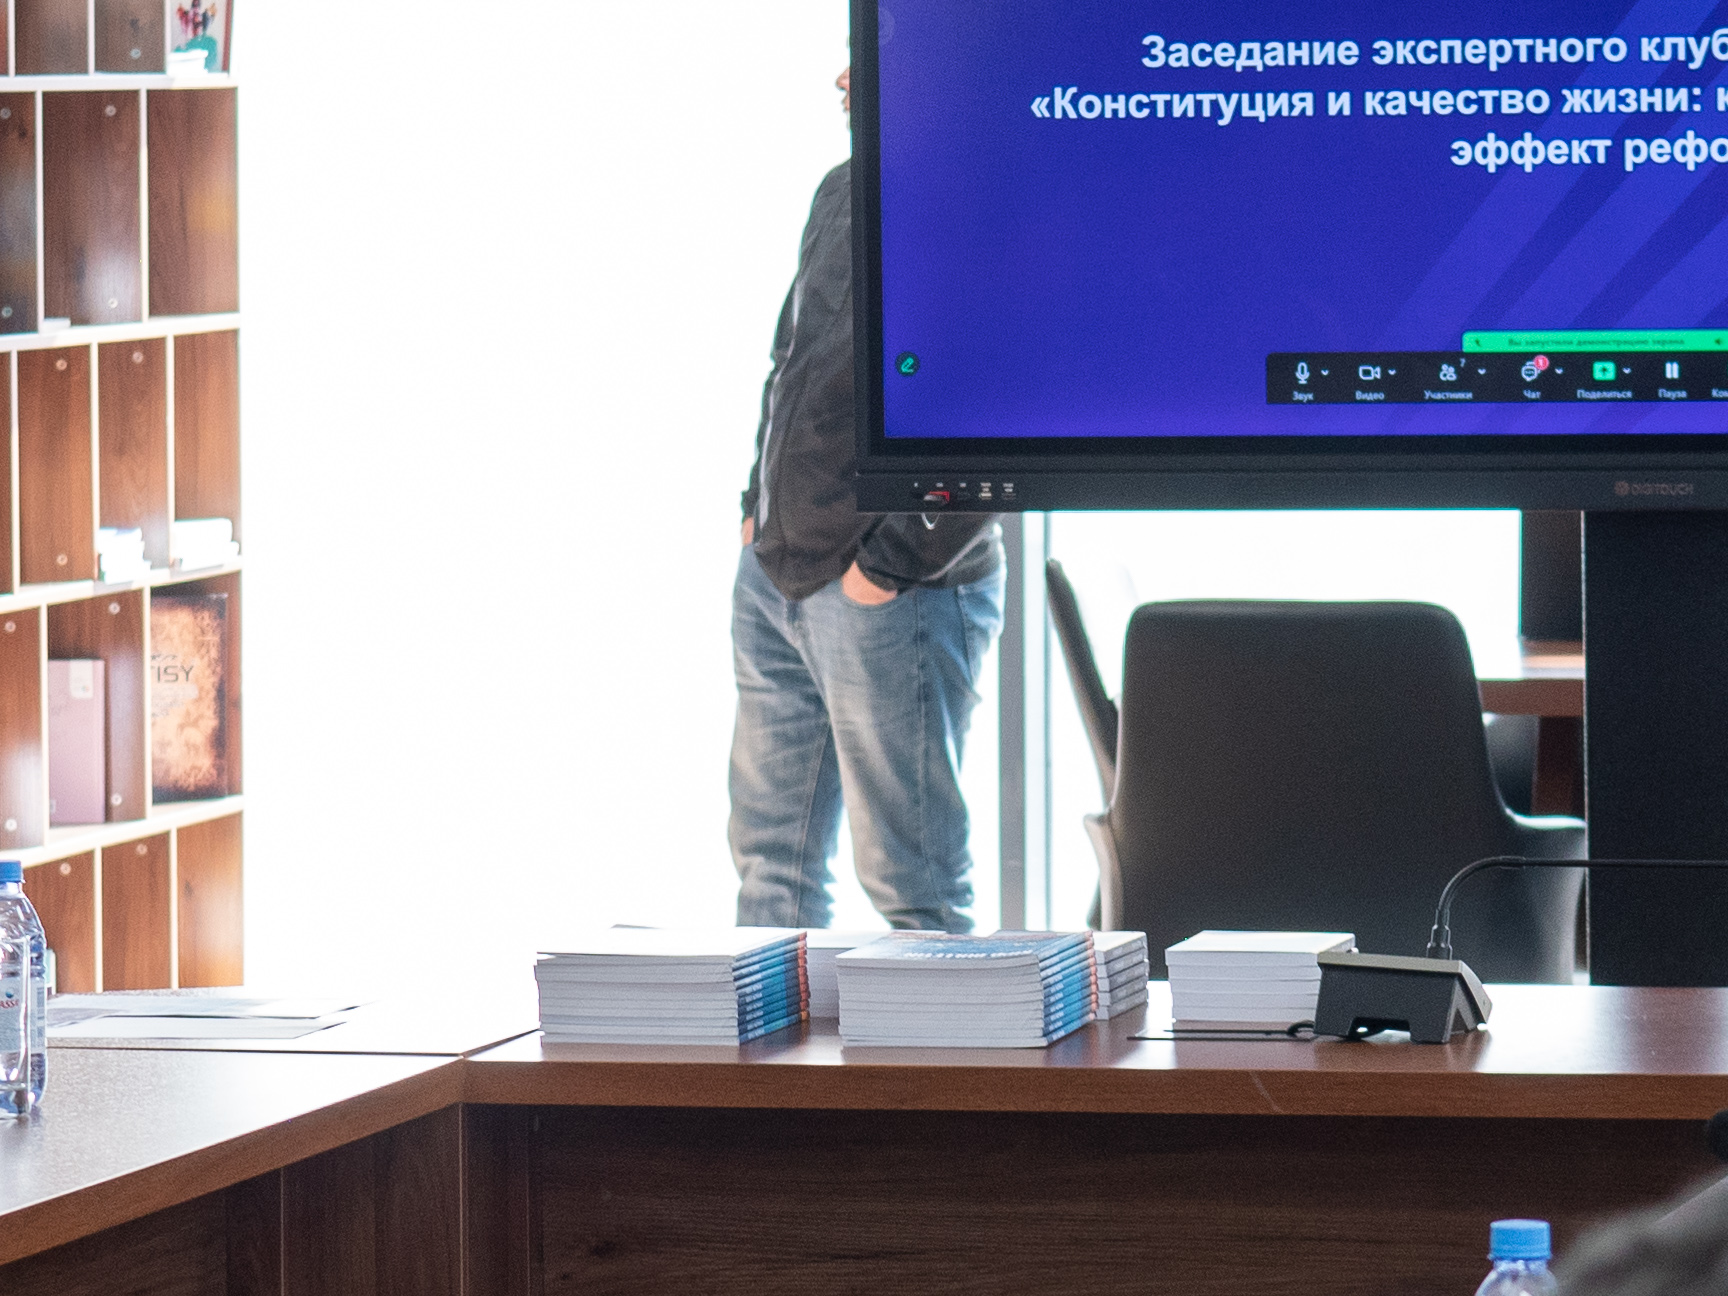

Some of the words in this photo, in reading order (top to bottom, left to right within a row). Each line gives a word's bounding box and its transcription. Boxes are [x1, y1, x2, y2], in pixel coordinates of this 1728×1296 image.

[1141, 35, 1360, 72] Заседание
[1372, 36, 1628, 72] экспертного
[1030, 86, 1314, 126] «Конституция
[1327, 89, 1352, 116] и
[1365, 88, 1551, 116] качество
[1561, 85, 1703, 113] жизни:
[1450, 132, 1612, 173] эффект
[1355, 390, 1385, 402] Видео
[1523, 389, 1541, 400] Чат
